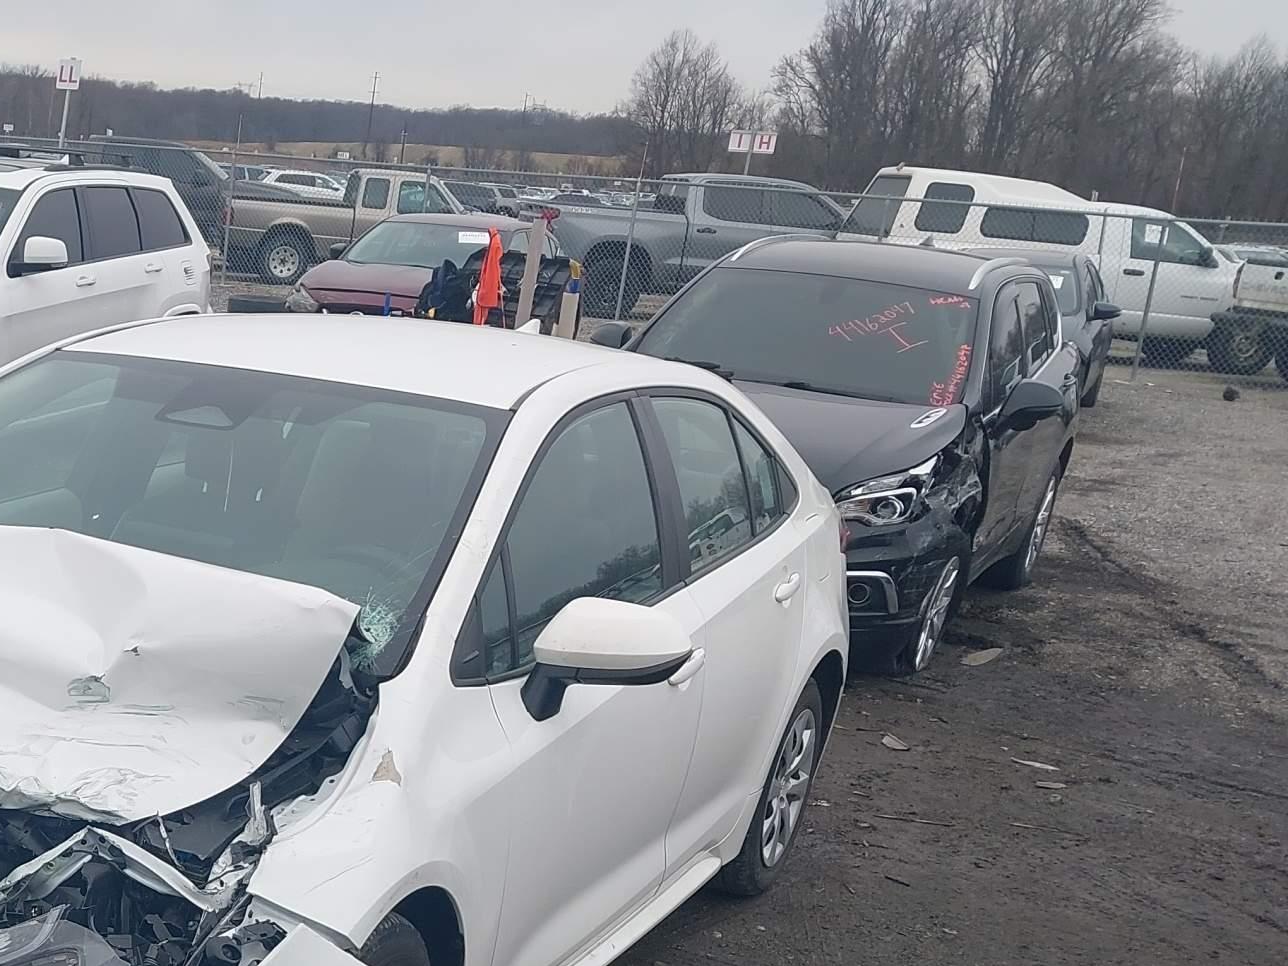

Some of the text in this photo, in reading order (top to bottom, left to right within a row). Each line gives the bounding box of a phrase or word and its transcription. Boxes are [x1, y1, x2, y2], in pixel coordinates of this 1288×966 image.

[58, 65, 78, 83] LL
[759, 134, 772, 150] H
[828, 301, 916, 342] 44162047
